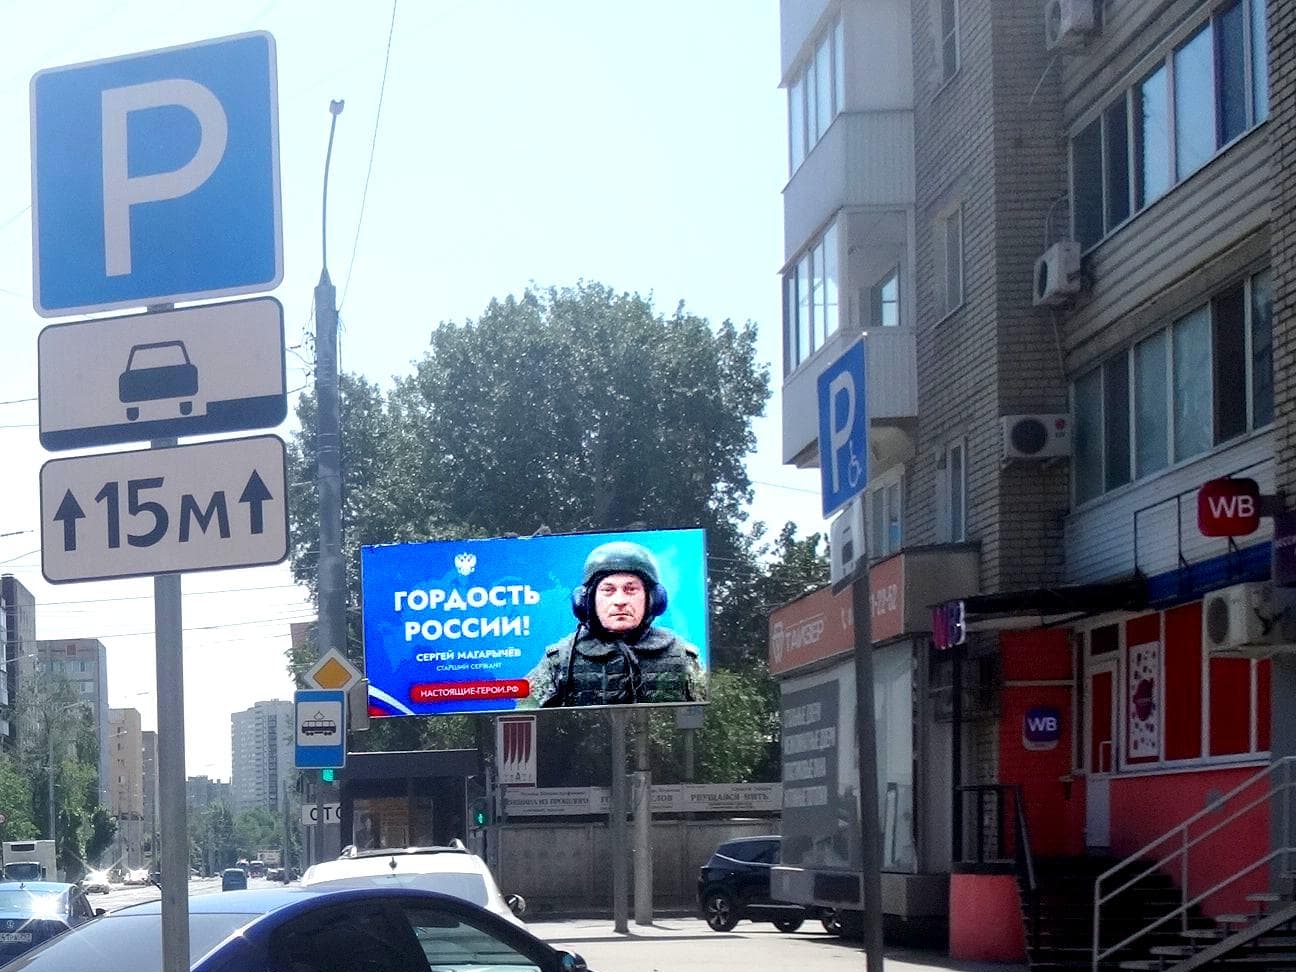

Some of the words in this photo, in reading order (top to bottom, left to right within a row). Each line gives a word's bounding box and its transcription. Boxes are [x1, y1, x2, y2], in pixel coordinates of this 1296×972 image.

[101, 78, 228, 278] P
[829, 370, 856, 494] P
[1207, 494, 1255, 519] WB
[394, 584, 541, 612] ГОРДОСТЬ
[405, 615, 531, 642] РОССИИ!
[416, 649, 455, 662] СЕРГЕЙ
[420, 685, 520, 698] НАСТОЯЩИЕ-ГЕРОИ.РФ
[1027, 716, 1057, 732] WB
[309, 806, 342, 821] СТО
